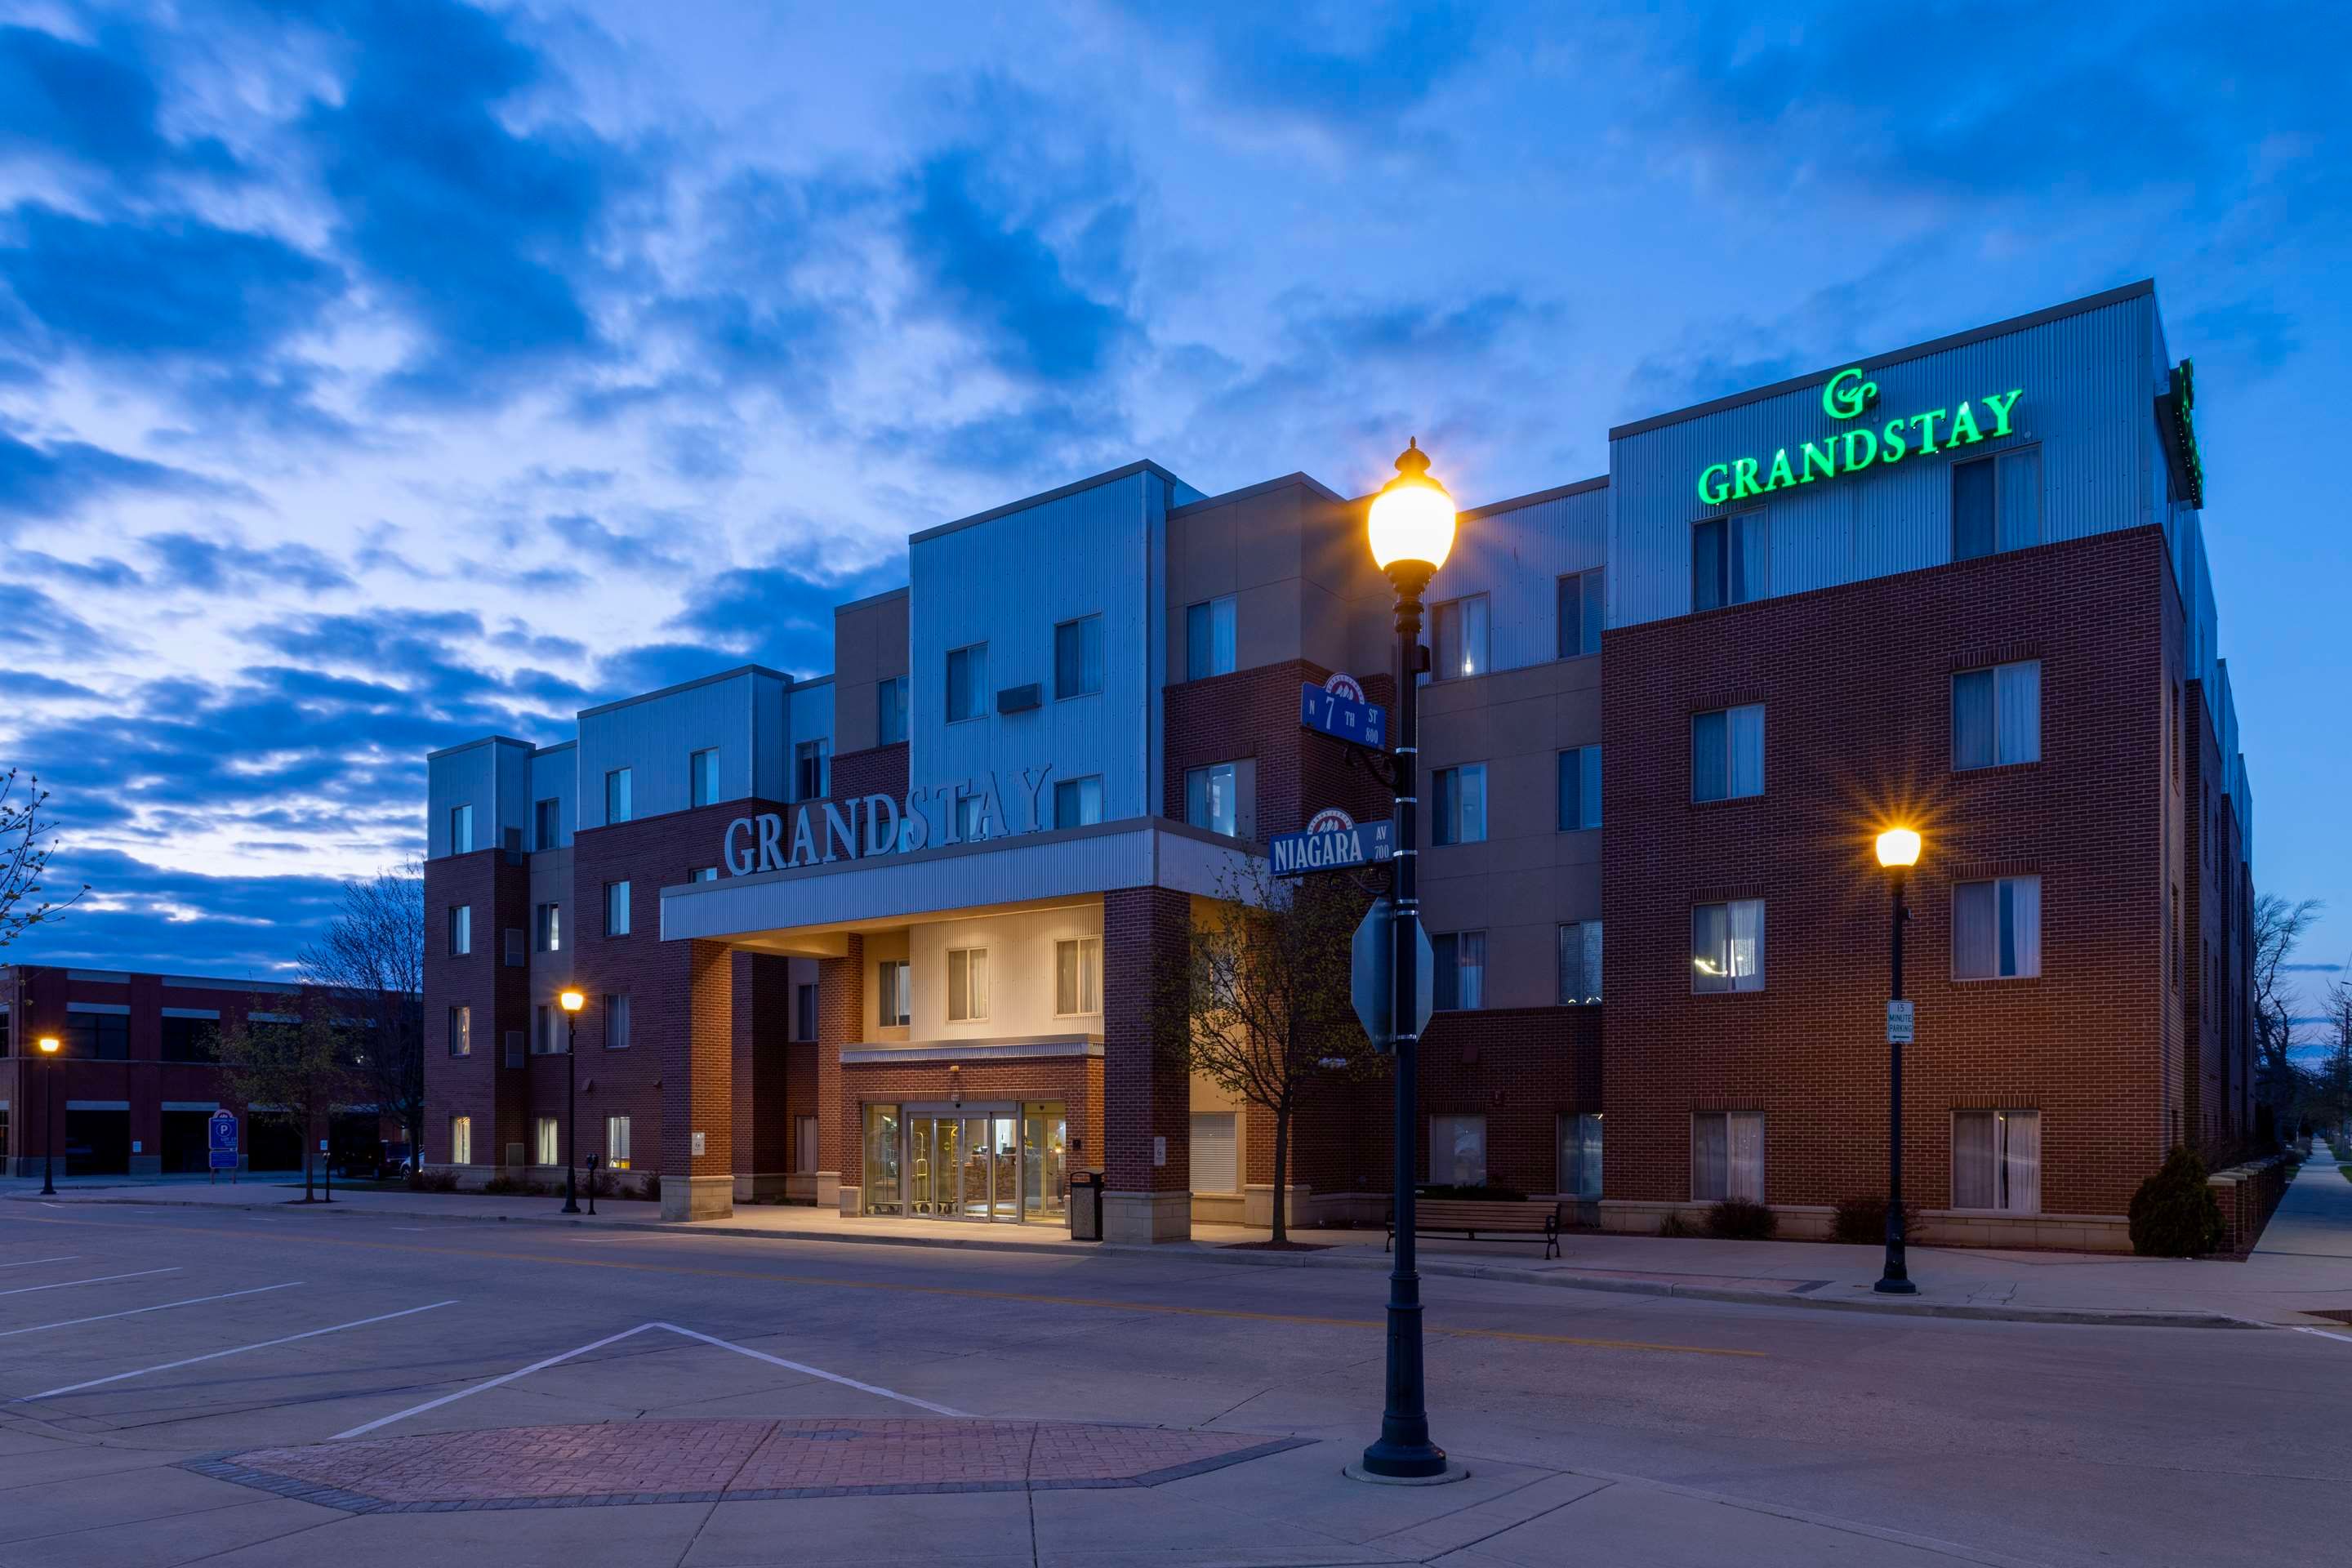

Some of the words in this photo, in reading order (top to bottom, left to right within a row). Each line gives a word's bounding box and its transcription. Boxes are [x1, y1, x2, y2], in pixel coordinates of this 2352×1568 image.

[1697, 388, 2024, 506] GRANDSTAY
[1309, 699, 1315, 715] N
[1325, 697, 1334, 730] 7
[1344, 710, 1355, 728] TH
[1368, 708, 1379, 724] ST
[1365, 727, 1379, 744] 800
[724, 763, 1052, 878] GRANDSTAY
[1274, 830, 1363, 871] NIAGARA
[1375, 826, 1388, 840] AV
[1374, 844, 1389, 860] 700
[1897, 1004, 1904, 1013] 15
[1889, 1014, 1912, 1022] MINUTE
[1889, 1024, 1912, 1033] PARKING
[220, 1125, 228, 1134] P
